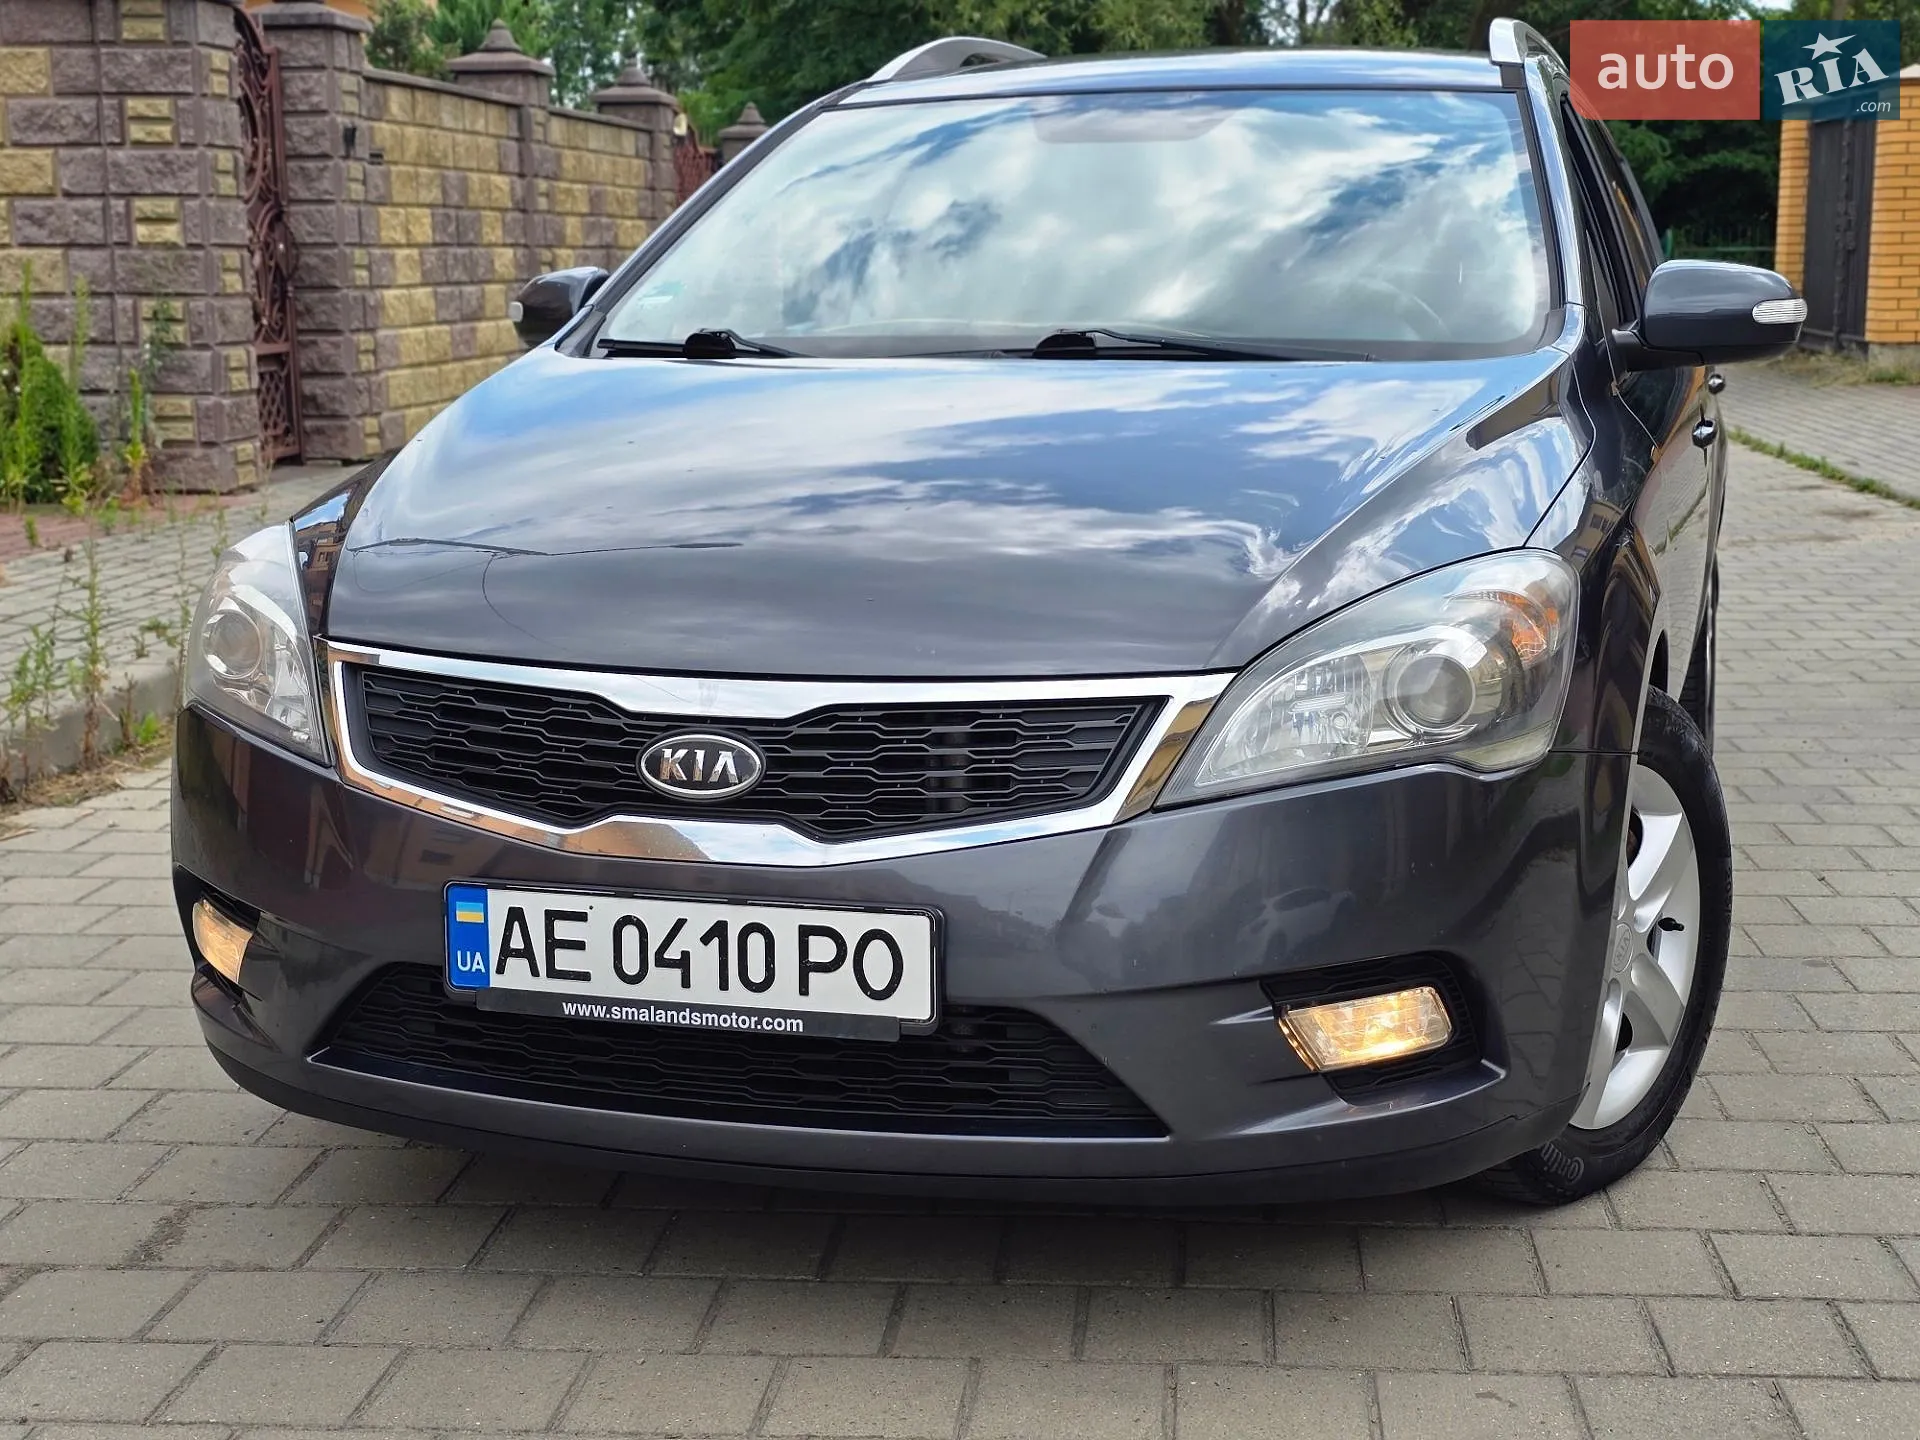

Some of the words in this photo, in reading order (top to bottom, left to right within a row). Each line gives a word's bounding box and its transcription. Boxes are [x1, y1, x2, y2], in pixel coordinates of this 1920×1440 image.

[660, 748, 739, 784] KIA
[457, 951, 486, 974] UA
[495, 906, 592, 982] AE
[612, 914, 776, 994] 0410
[798, 925, 904, 1001] PO
[562, 1000, 804, 1033] www.smalandsmotor.com
